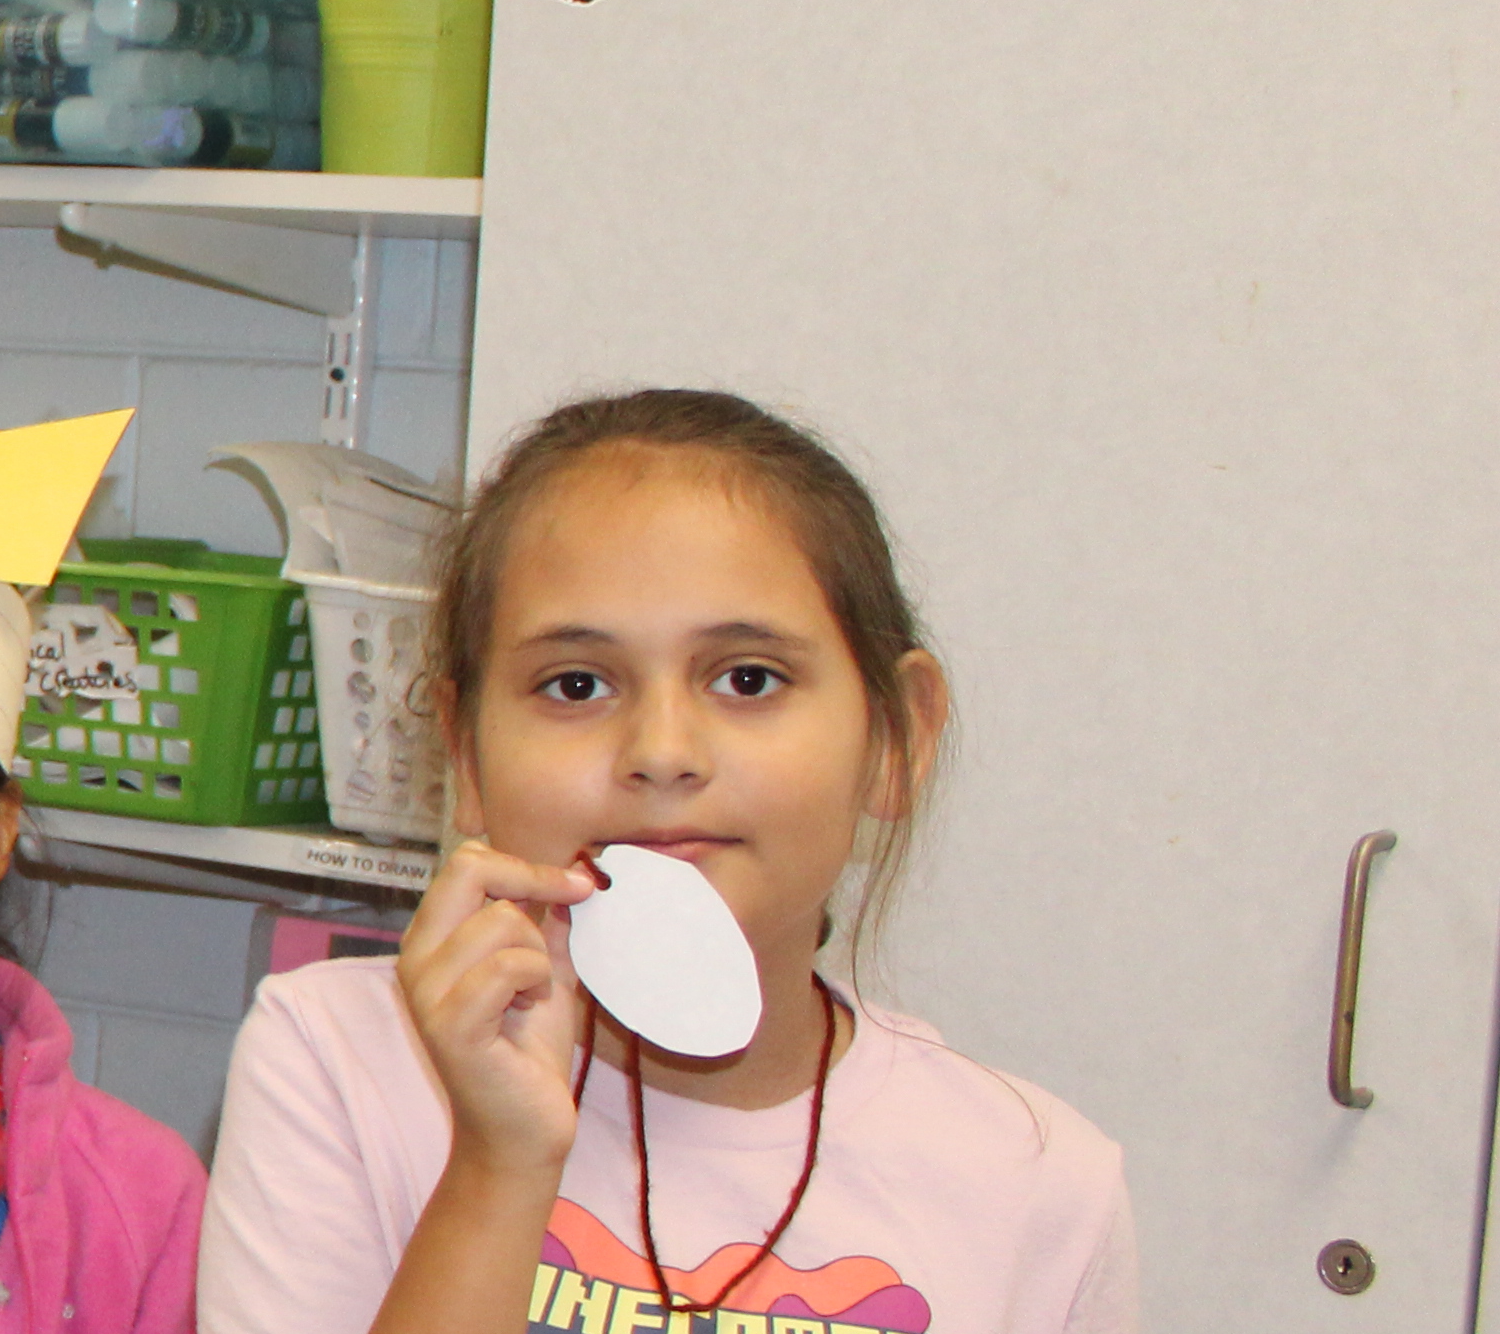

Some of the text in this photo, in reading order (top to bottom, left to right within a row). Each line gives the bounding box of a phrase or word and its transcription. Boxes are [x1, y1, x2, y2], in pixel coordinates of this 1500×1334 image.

[307, 850, 426, 879] HOW TO DRAW
